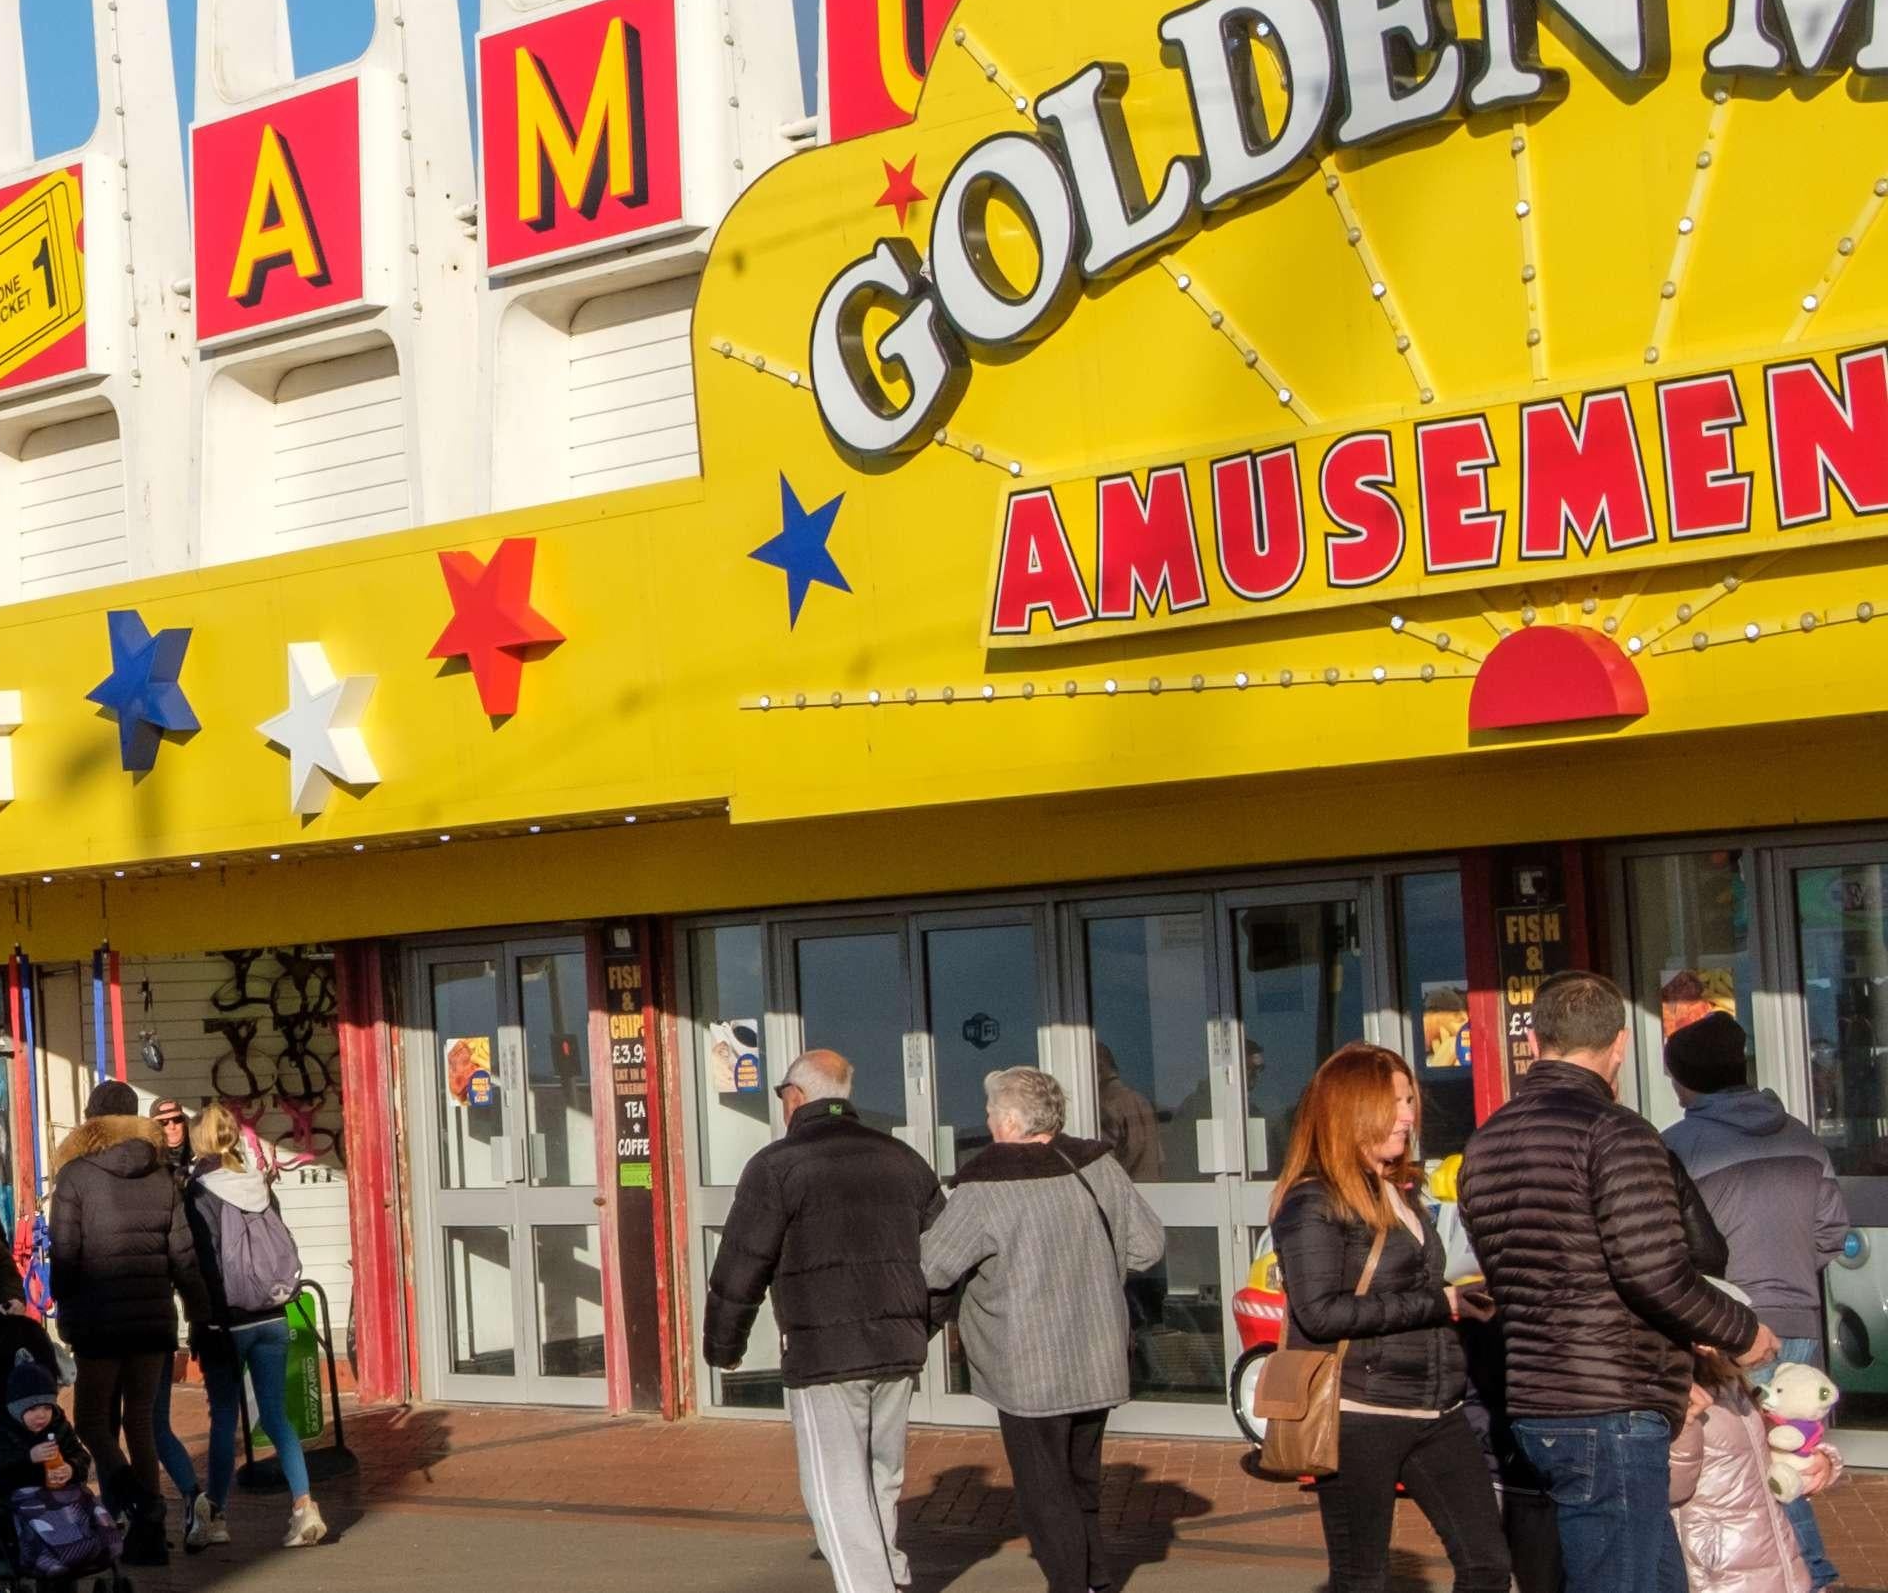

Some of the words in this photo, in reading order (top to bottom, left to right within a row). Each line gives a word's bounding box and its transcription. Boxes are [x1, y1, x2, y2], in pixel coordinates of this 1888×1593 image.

[992, 347, 1888, 635] AMUSEMEN
[1505, 913, 1560, 944] FISH
[1526, 946, 1543, 970] &
[608, 965, 641, 990] FISH
[622, 991, 634, 1011] &
[625, 1101, 646, 1118] TEA
